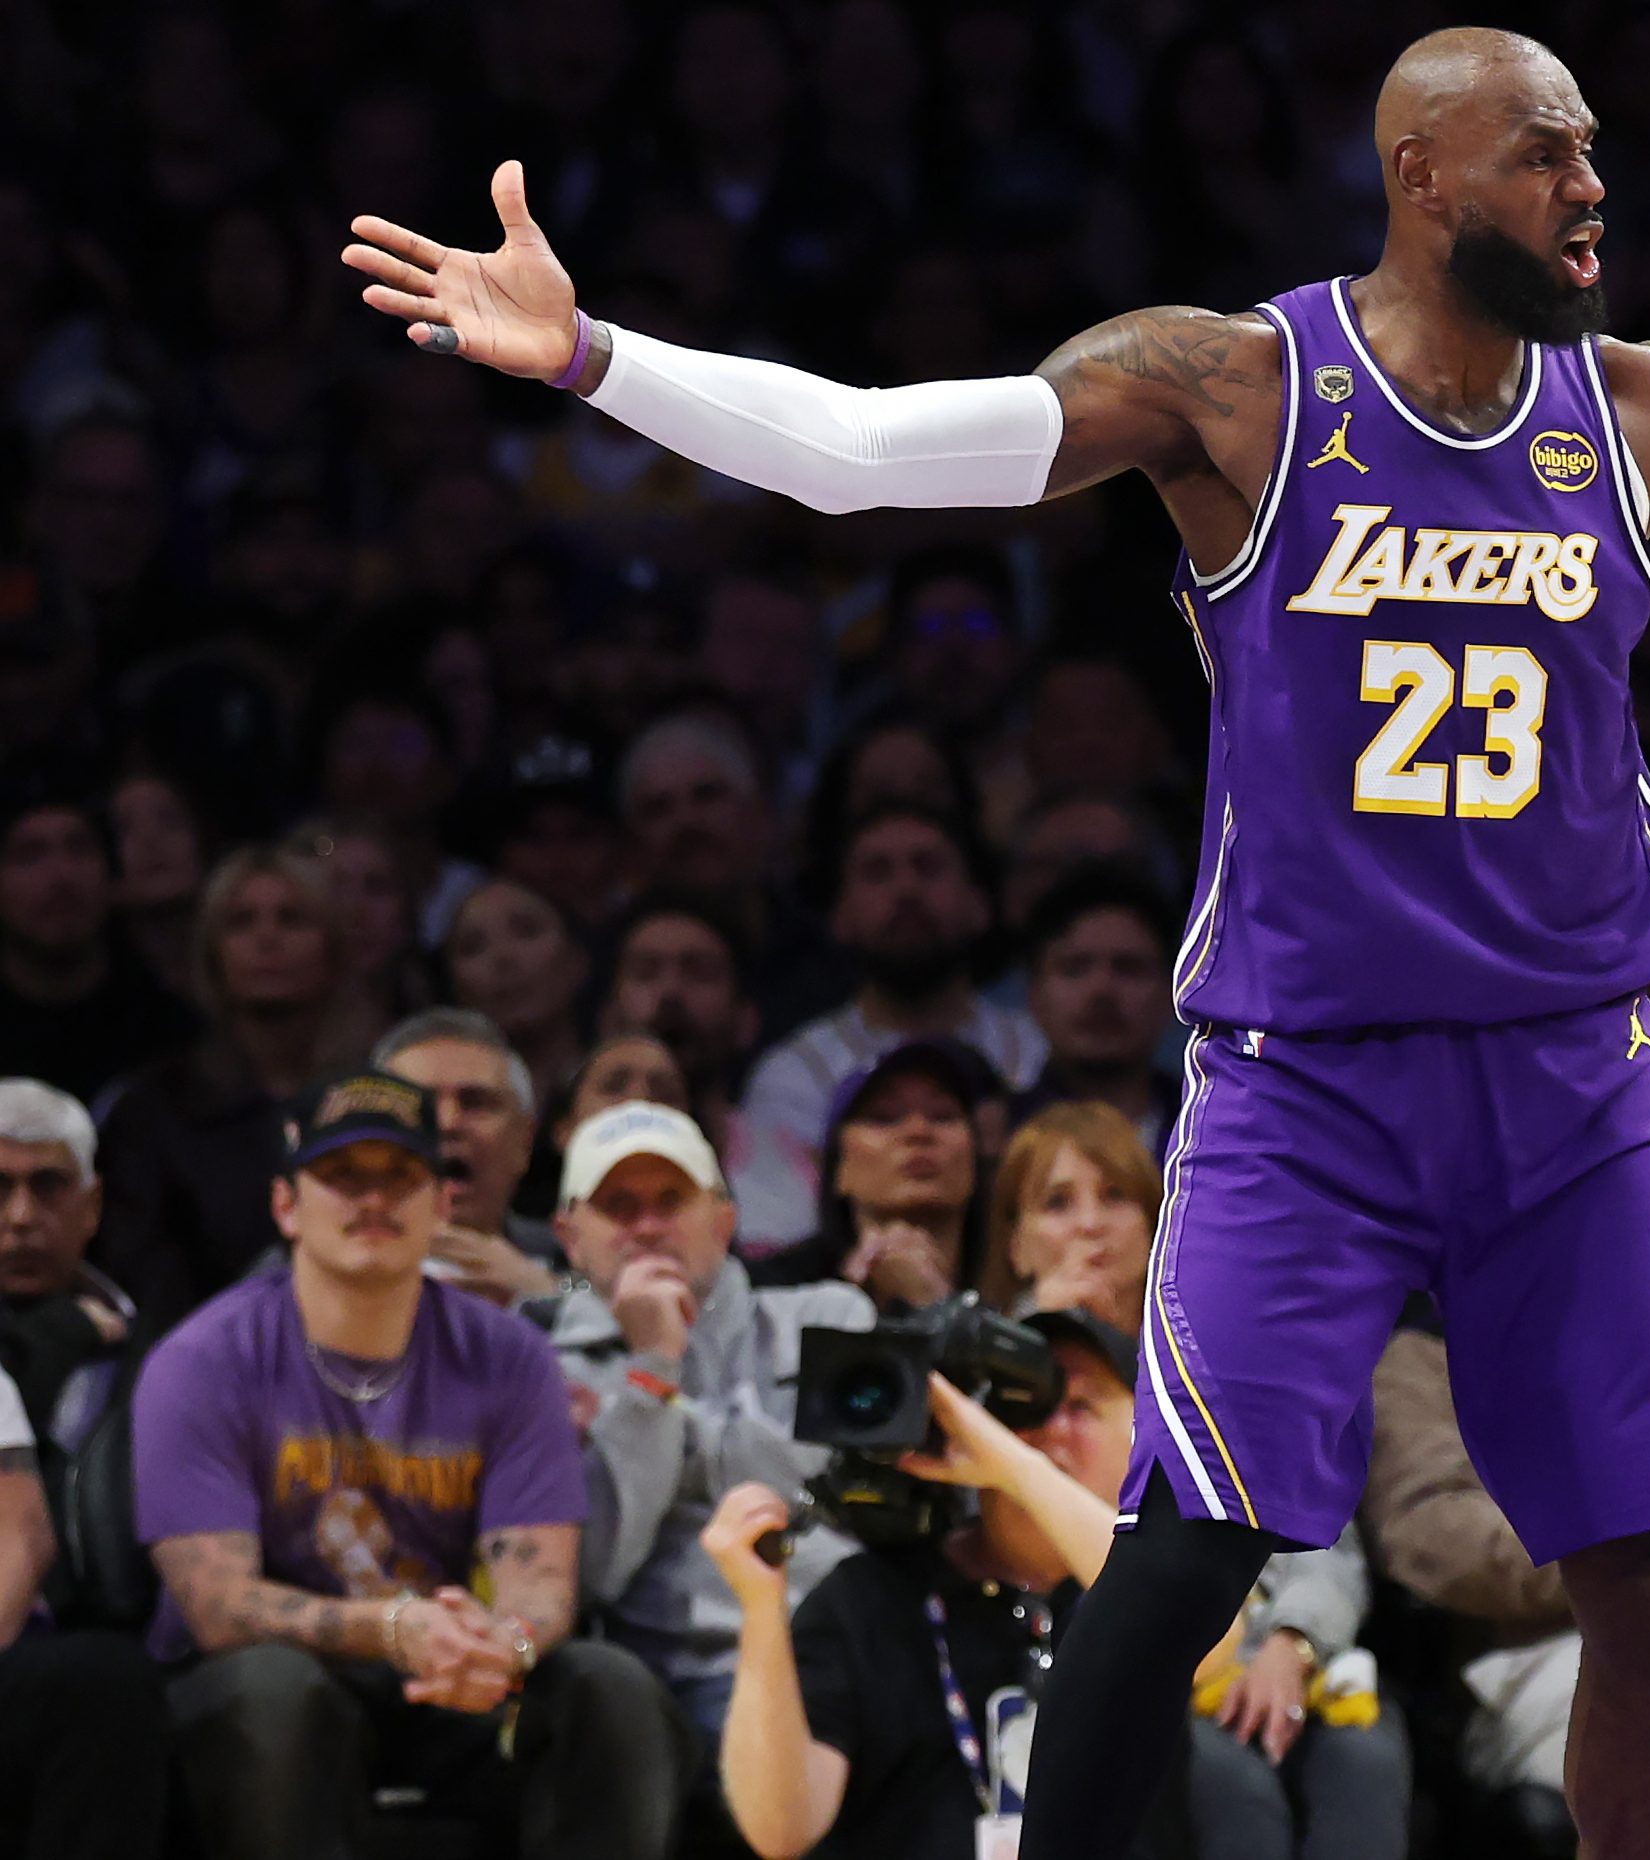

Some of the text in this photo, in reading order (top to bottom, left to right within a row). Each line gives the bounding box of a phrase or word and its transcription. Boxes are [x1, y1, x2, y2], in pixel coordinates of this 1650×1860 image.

[1535, 446, 1592, 475] bibigo
[1286, 503, 1598, 622] LAKERS
[1352, 640, 1548, 819] 23
